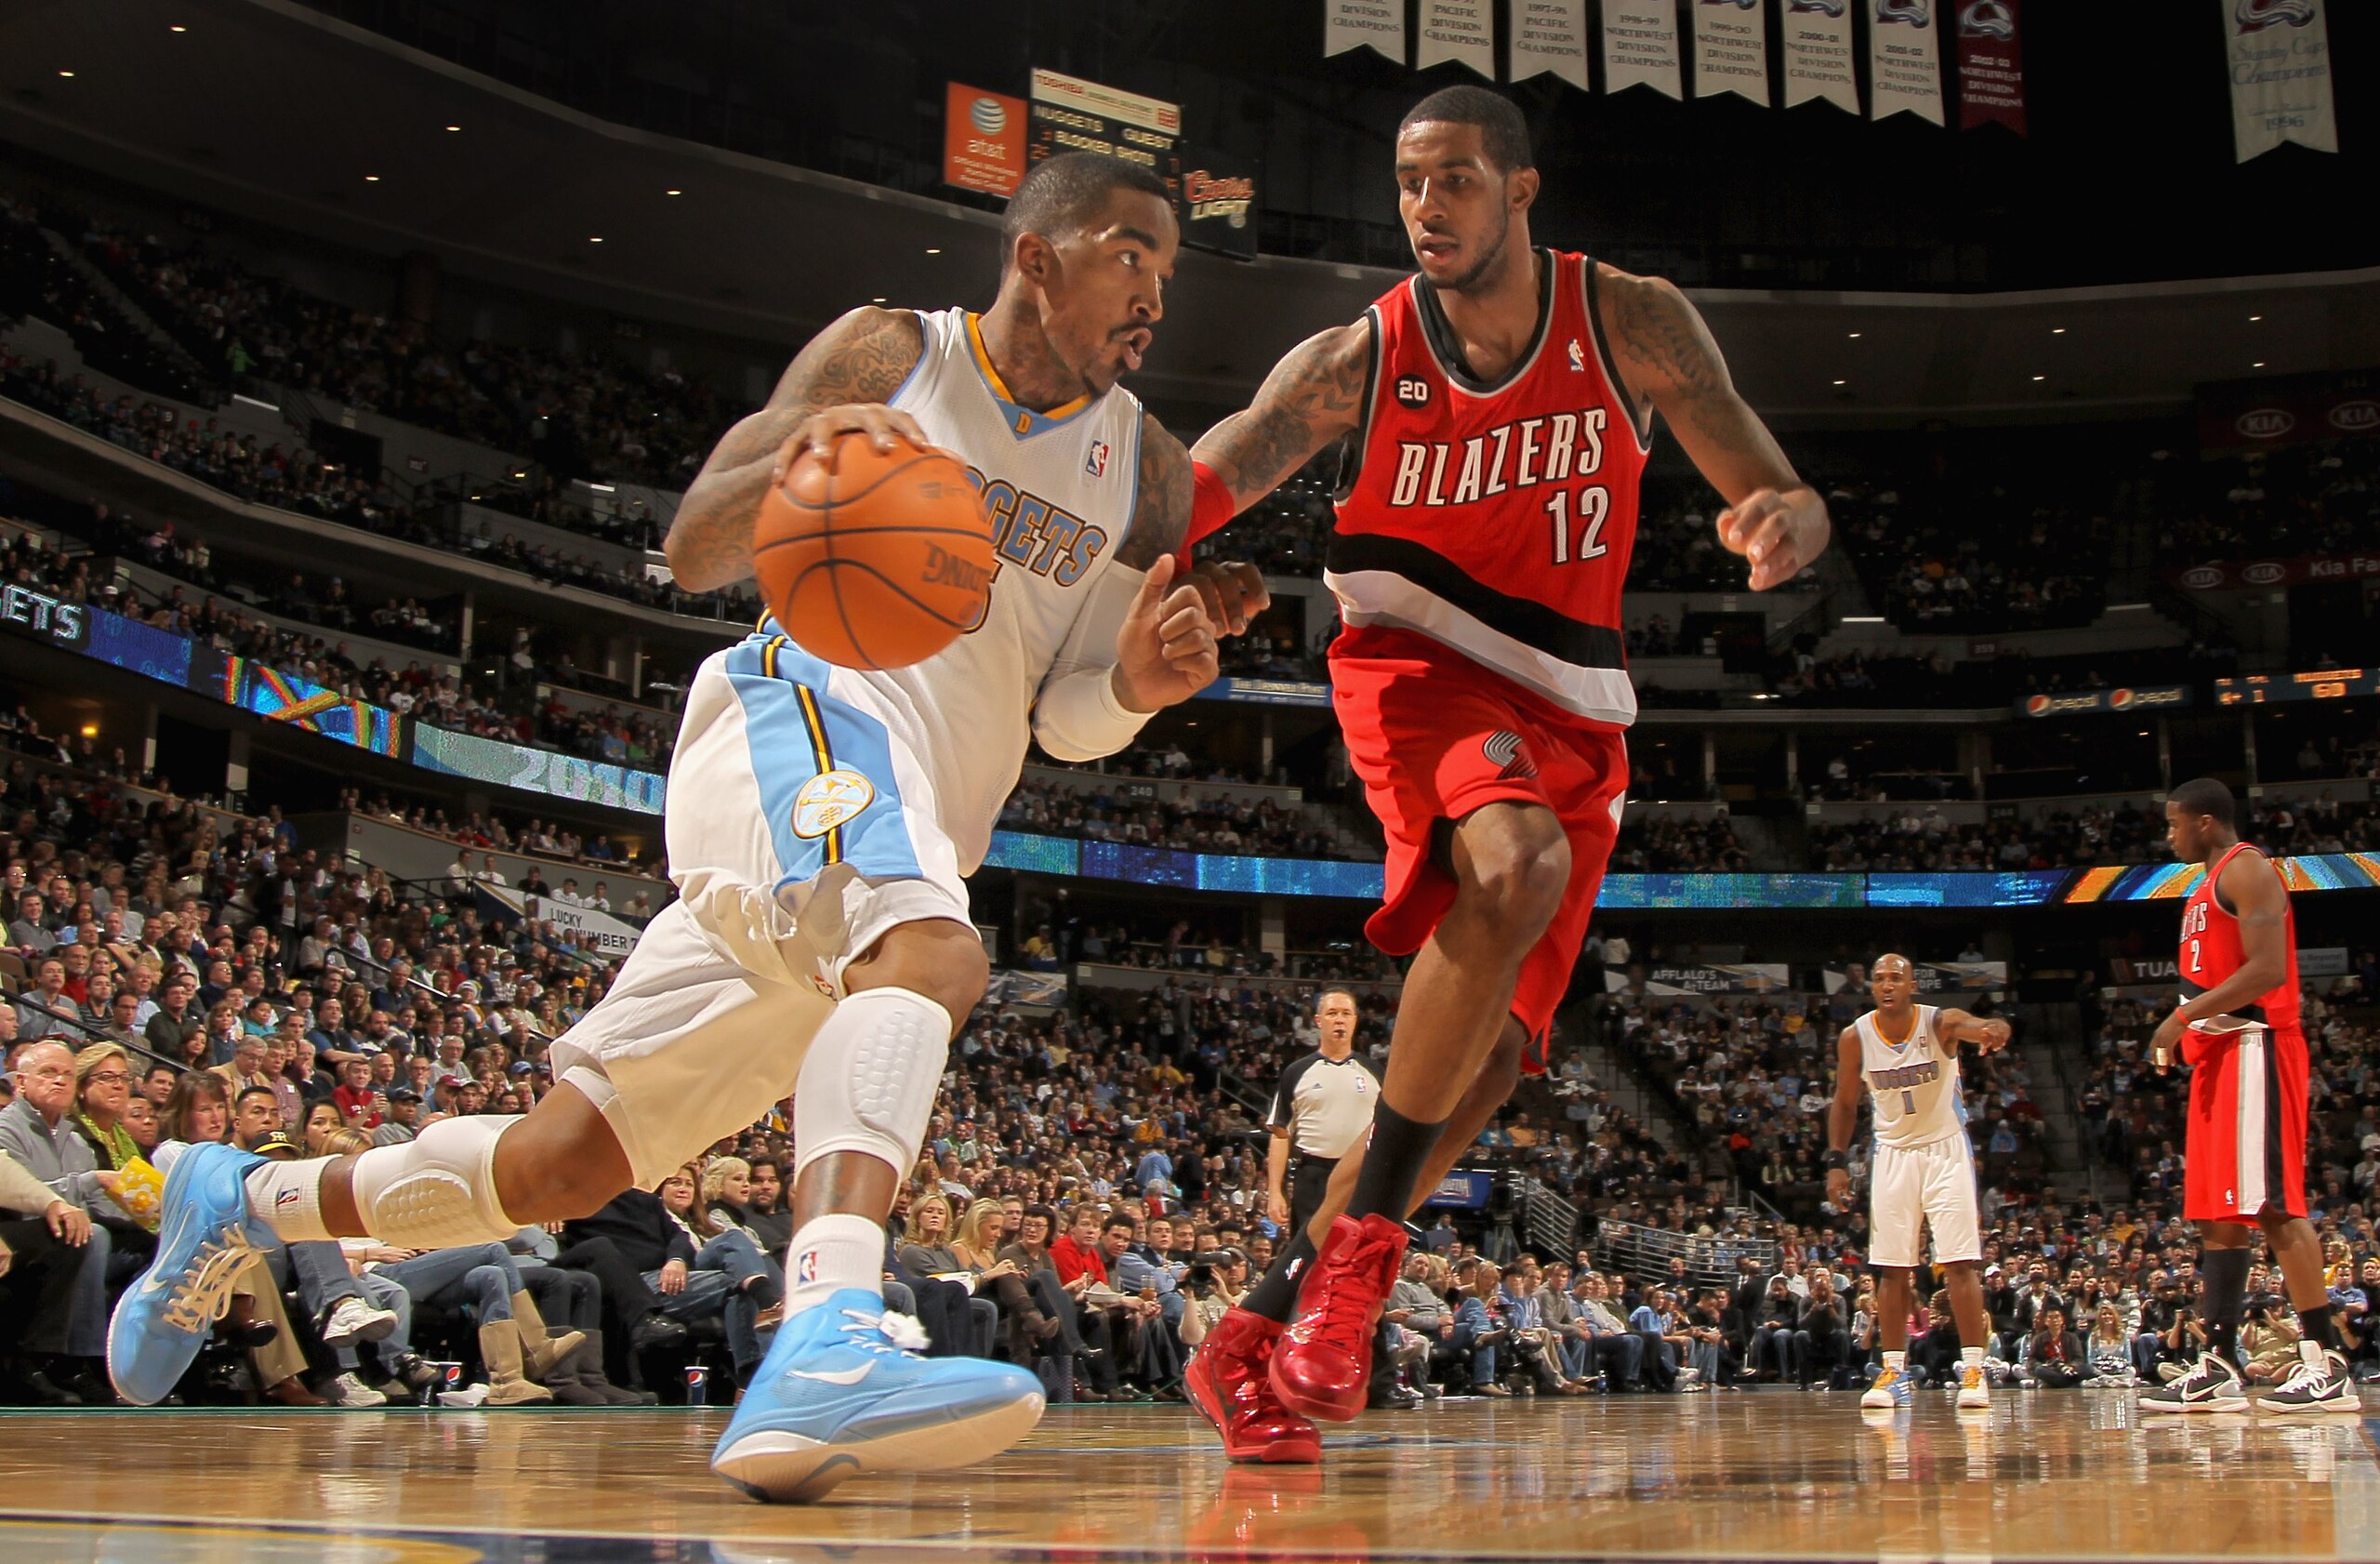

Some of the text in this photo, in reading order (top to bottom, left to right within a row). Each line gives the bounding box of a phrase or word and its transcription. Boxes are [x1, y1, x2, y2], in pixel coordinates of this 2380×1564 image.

[1342, 5, 1391, 17] DIVISION
[1435, 5, 1477, 18] PACIFIC
[1333, 17, 1399, 32] CHAMPIONS
[1432, 19, 1481, 31] DIVISION
[1526, 17, 1569, 29] PACIFIC
[1425, 29, 1489, 46] CHAMPIONS
[1523, 30, 1574, 43] DIVISION
[1606, 27, 1673, 41] NORTHWEST
[1698, 34, 1763, 49] NORTHWEST
[1517, 41, 1581, 58] CHAMPIONS
[1617, 41, 1666, 54] DIVISION
[1708, 48, 1755, 62] DIVISION
[1786, 42, 1848, 56] NORTHWES
[1611, 55, 1675, 68] CHAMPIONS
[1797, 57, 1845, 69] DIVISION
[1875, 55, 1936, 71] NORTHWEST
[1700, 63, 1763, 77] CHAMPIONS
[1791, 69, 1852, 84] CHAMPIONS
[1884, 69, 1930, 82] DIVISION
[1960, 66, 2022, 81] NORTHWEST
[1035, 73, 1085, 94] TOSHIBA
[1876, 82, 1938, 97] CHAMPIONS
[1967, 80, 2015, 93] DIVISION
[1963, 93, 2024, 107] CHAMPIONS
[1034, 104, 1104, 133] NUGGETS
[1121, 128, 1174, 150] GUEST
[1054, 130, 1113, 154] BLOCKED
[1116, 146, 1157, 166] SHOTS
[1190, 199, 1252, 220] LIGHT
[1398, 379, 1428, 401] 20
[2246, 406, 2379, 431] KIA KIA
[1389, 406, 1607, 507] BLAZERS
[965, 464, 1107, 587] GETS
[1545, 485, 1609, 563] 12
[2188, 570, 2218, 585] KIA
[2310, 560, 2346, 577] Kia
[0, 581, 83, 640] ETS
[2053, 688, 2184, 711] pepsi pepsi
[550, 908, 582, 928] LUCKY
[2190, 938, 2202, 974] 2
[1651, 969, 1717, 980] AFFLALO'S
[1913, 968, 1937, 979] FOR
[1683, 980, 1730, 991] A-TEAM
[1916, 978, 1942, 989] OPE
[1869, 1060, 1940, 1091] NUGGETS
[1901, 1090, 1916, 1115] 1
